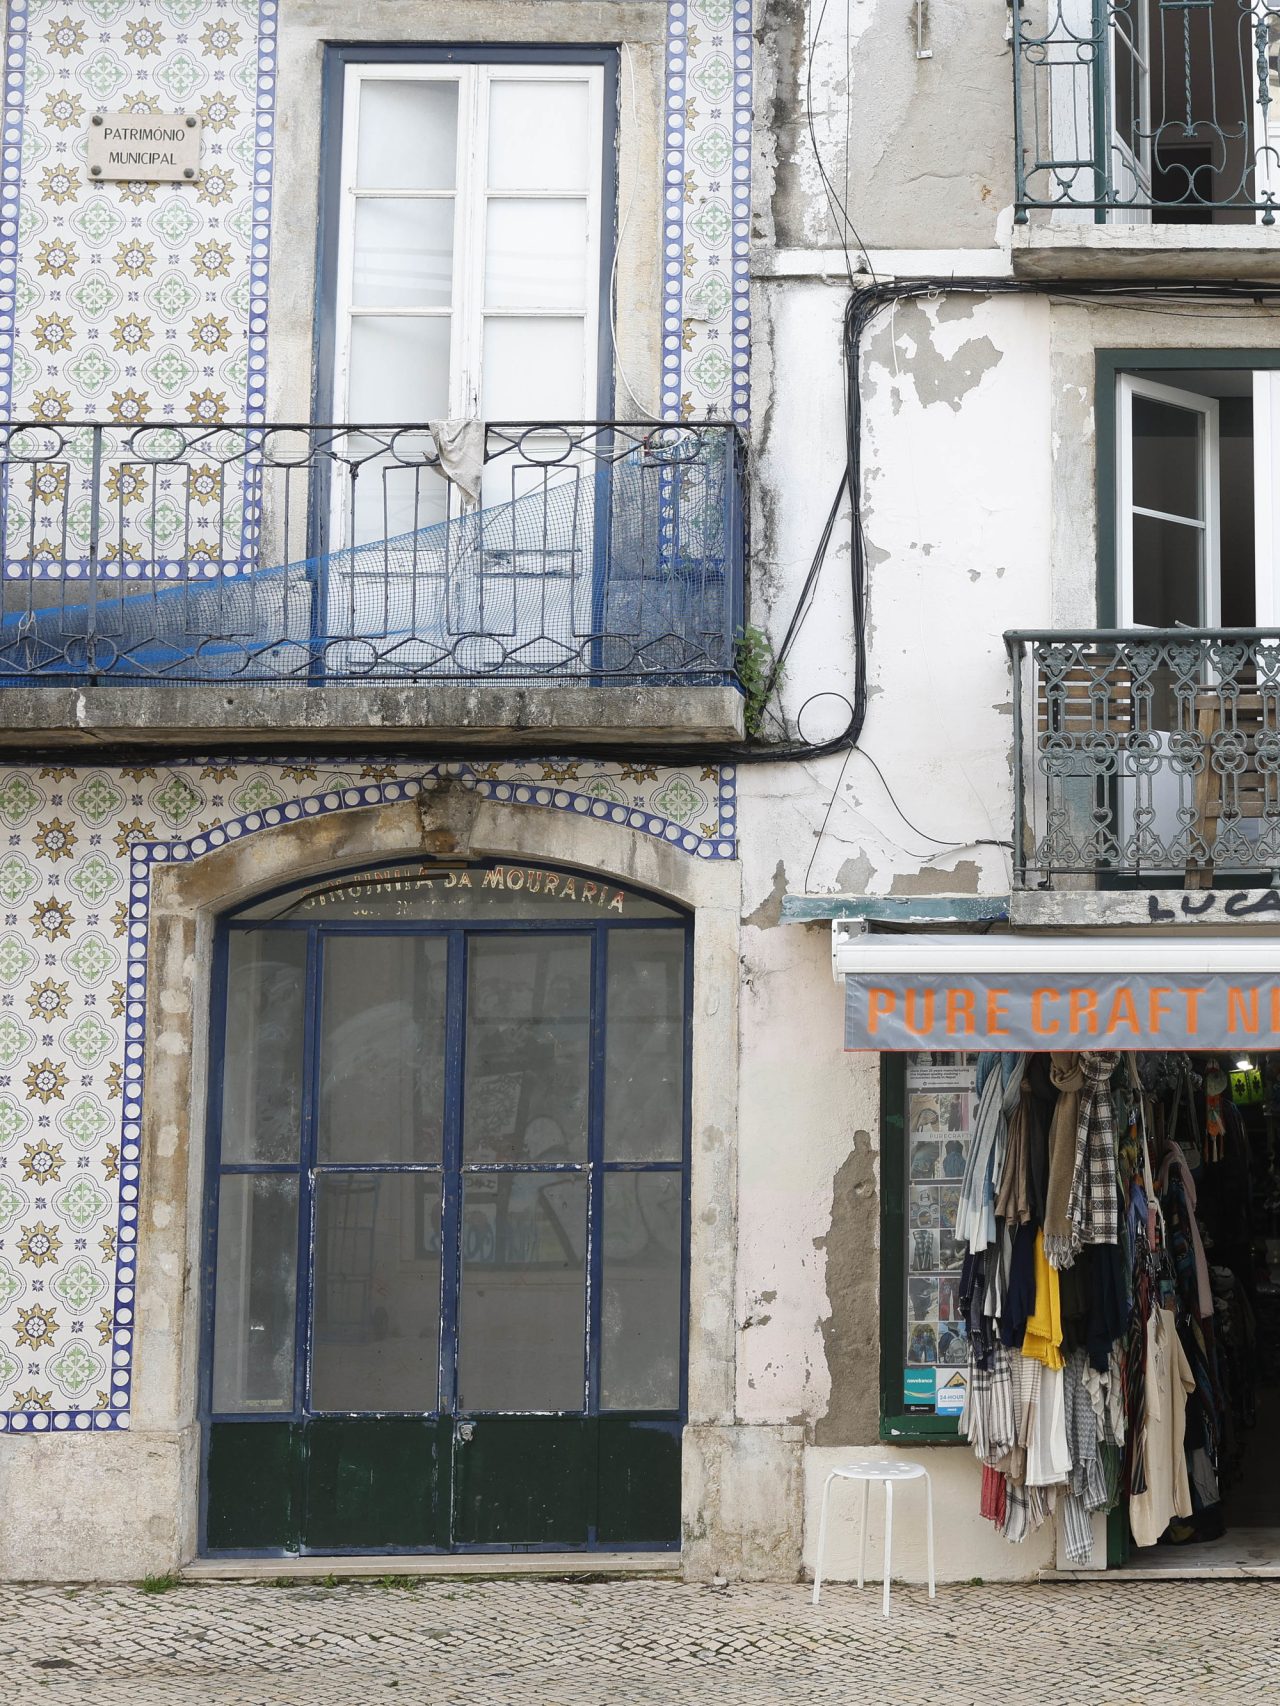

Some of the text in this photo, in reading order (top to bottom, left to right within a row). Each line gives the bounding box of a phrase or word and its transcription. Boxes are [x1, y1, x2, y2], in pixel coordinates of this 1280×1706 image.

[104, 126, 185, 141] PATRIMÓNIO
[108, 151, 177, 165] MUNICIPAL
[444, 872, 473, 888] DA
[481, 866, 625, 914] MOURARIA
[867, 987, 1010, 1036] PURE
[1031, 986, 1208, 1036] CRAFT
